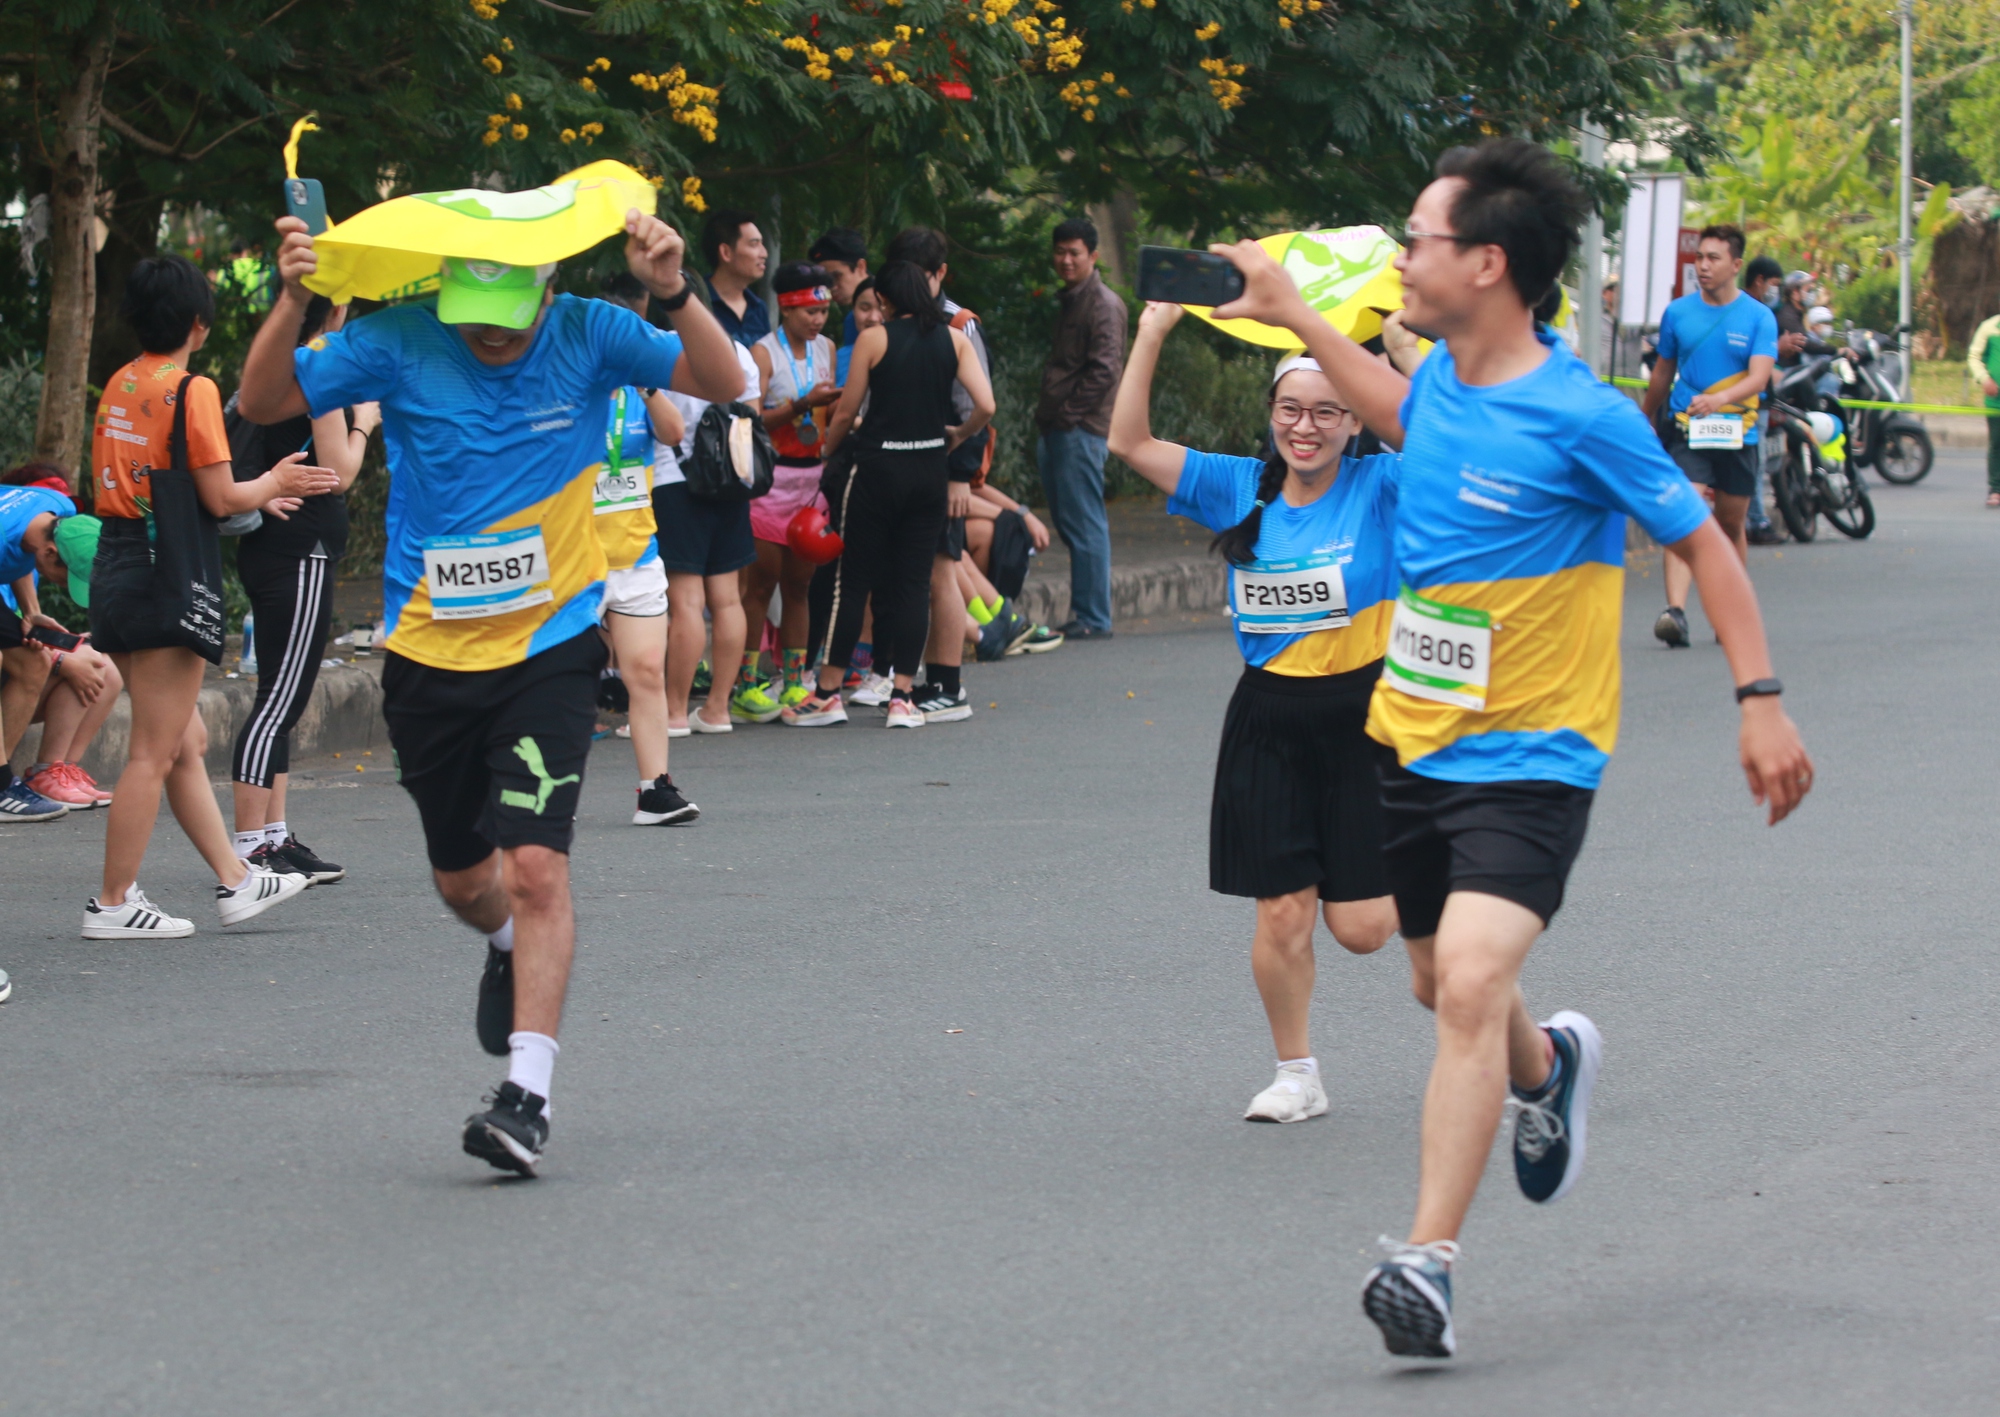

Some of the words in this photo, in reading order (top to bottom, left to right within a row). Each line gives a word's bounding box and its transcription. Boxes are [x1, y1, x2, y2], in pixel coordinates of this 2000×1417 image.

[1698, 424, 1733, 435] 21859
[882, 440, 914, 450] ADIDAS
[436, 552, 534, 587] M21587
[1244, 580, 1330, 606] F21359
